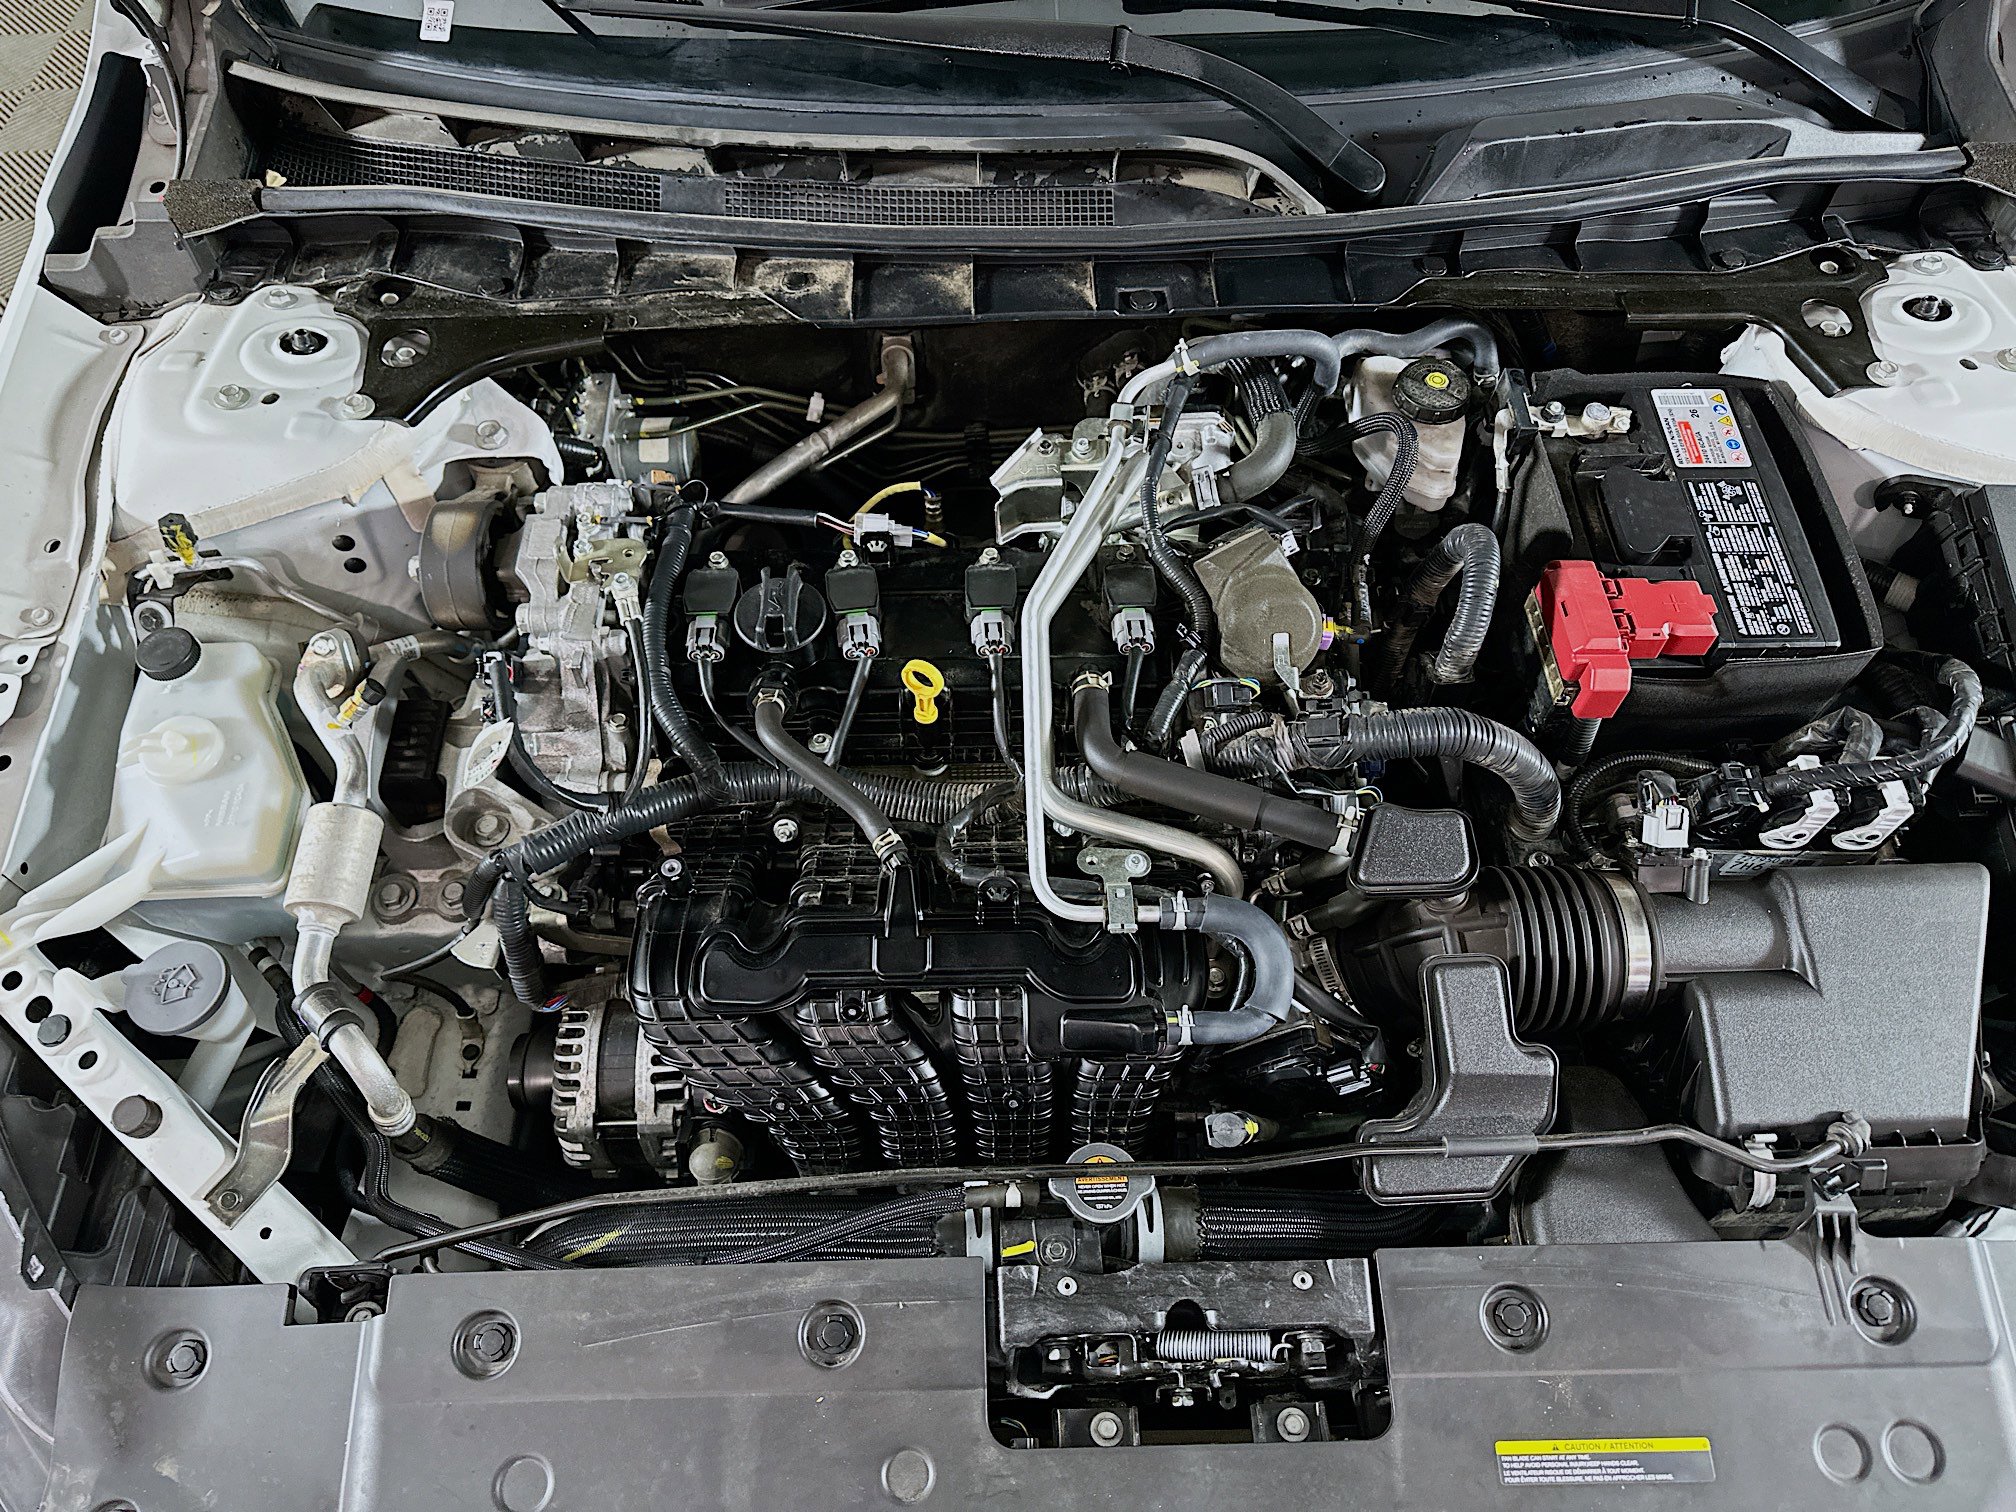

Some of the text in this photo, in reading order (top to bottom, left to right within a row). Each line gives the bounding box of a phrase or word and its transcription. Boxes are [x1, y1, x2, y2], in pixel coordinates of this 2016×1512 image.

[1688, 408, 1700, 418] 26
[1663, 417, 1684, 464] RENAULT NISSAN
[1036, 463, 1059, 474] FR
